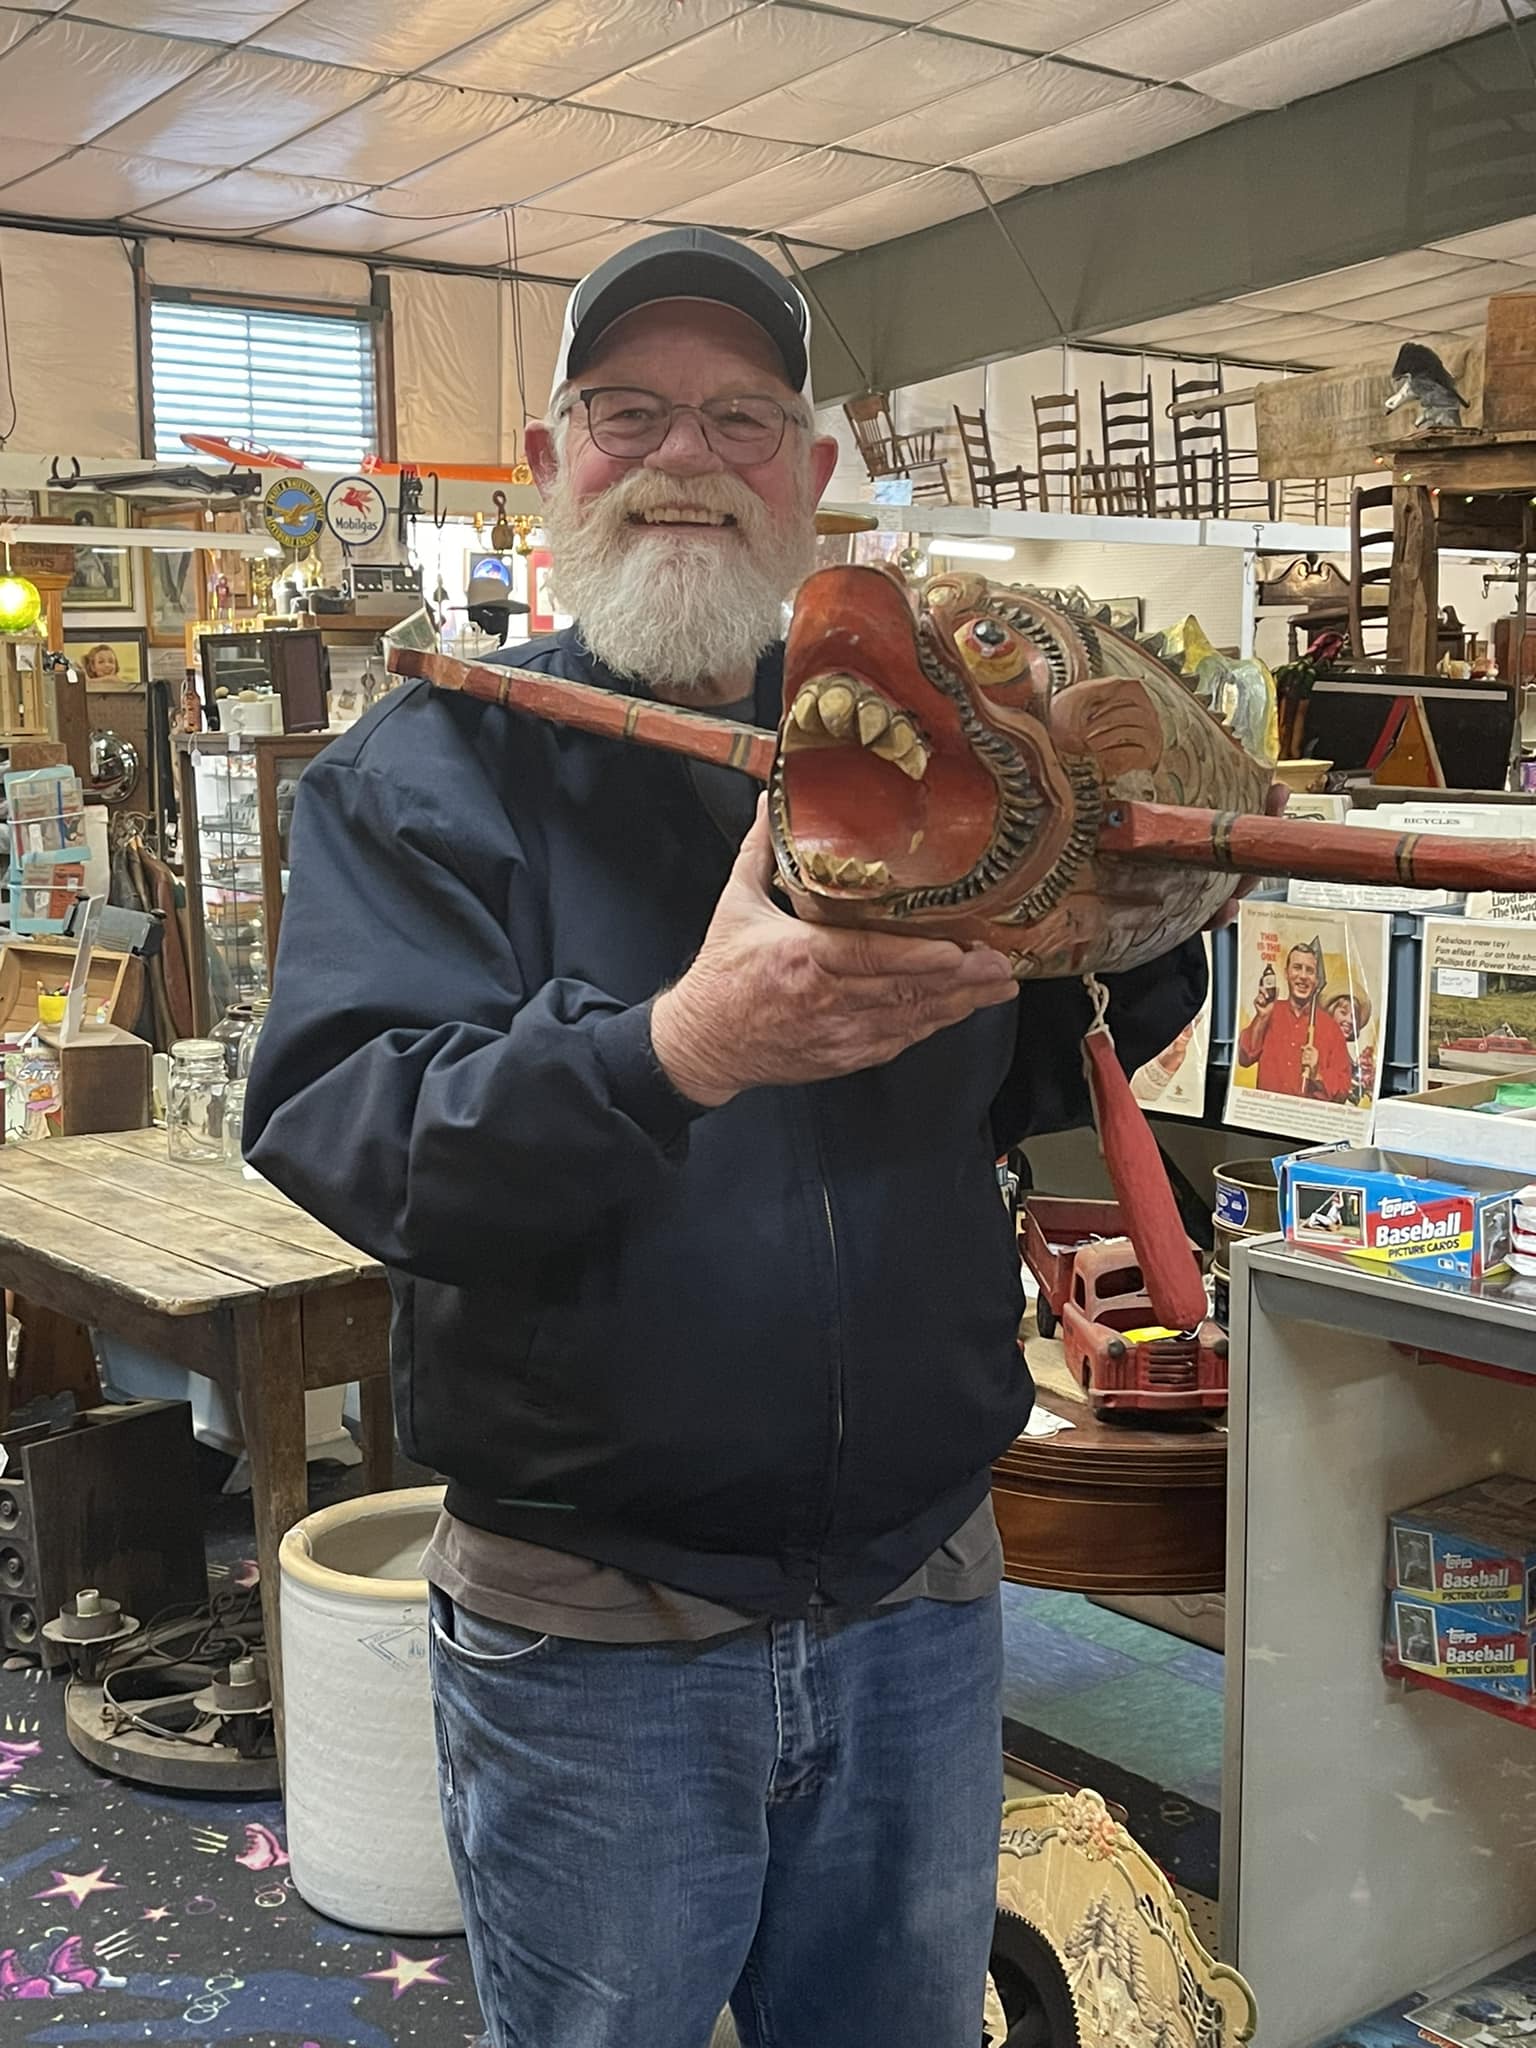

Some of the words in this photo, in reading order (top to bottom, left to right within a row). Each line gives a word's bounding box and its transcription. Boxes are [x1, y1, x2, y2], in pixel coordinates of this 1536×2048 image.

[335, 518, 378, 534] Mobilgas
[1404, 817, 1461, 826] BICYCLES
[1260, 931, 1278, 942] THIS
[1435, 935, 1472, 946] Fabulous
[1435, 946, 1450, 955] Fun
[1507, 952, 1521, 960] the
[1435, 957, 1464, 967] Phillips
[1466, 959, 1477, 968] 66
[1479, 959, 1505, 969] Power
[1375, 1212, 1461, 1247] Baseball
[1388, 1245, 1427, 1259] PICTURE
[1427, 1238, 1459, 1252] CARDS
[1442, 1568, 1510, 1589] Baseball
[1442, 1591, 1478, 1600] PICTURE
[1479, 1589, 1509, 1600] CARDS
[1446, 1643, 1515, 1664] Baseball
[1446, 1665, 1483, 1675] PICTURE
[1484, 1664, 1515, 1674] CARDS
